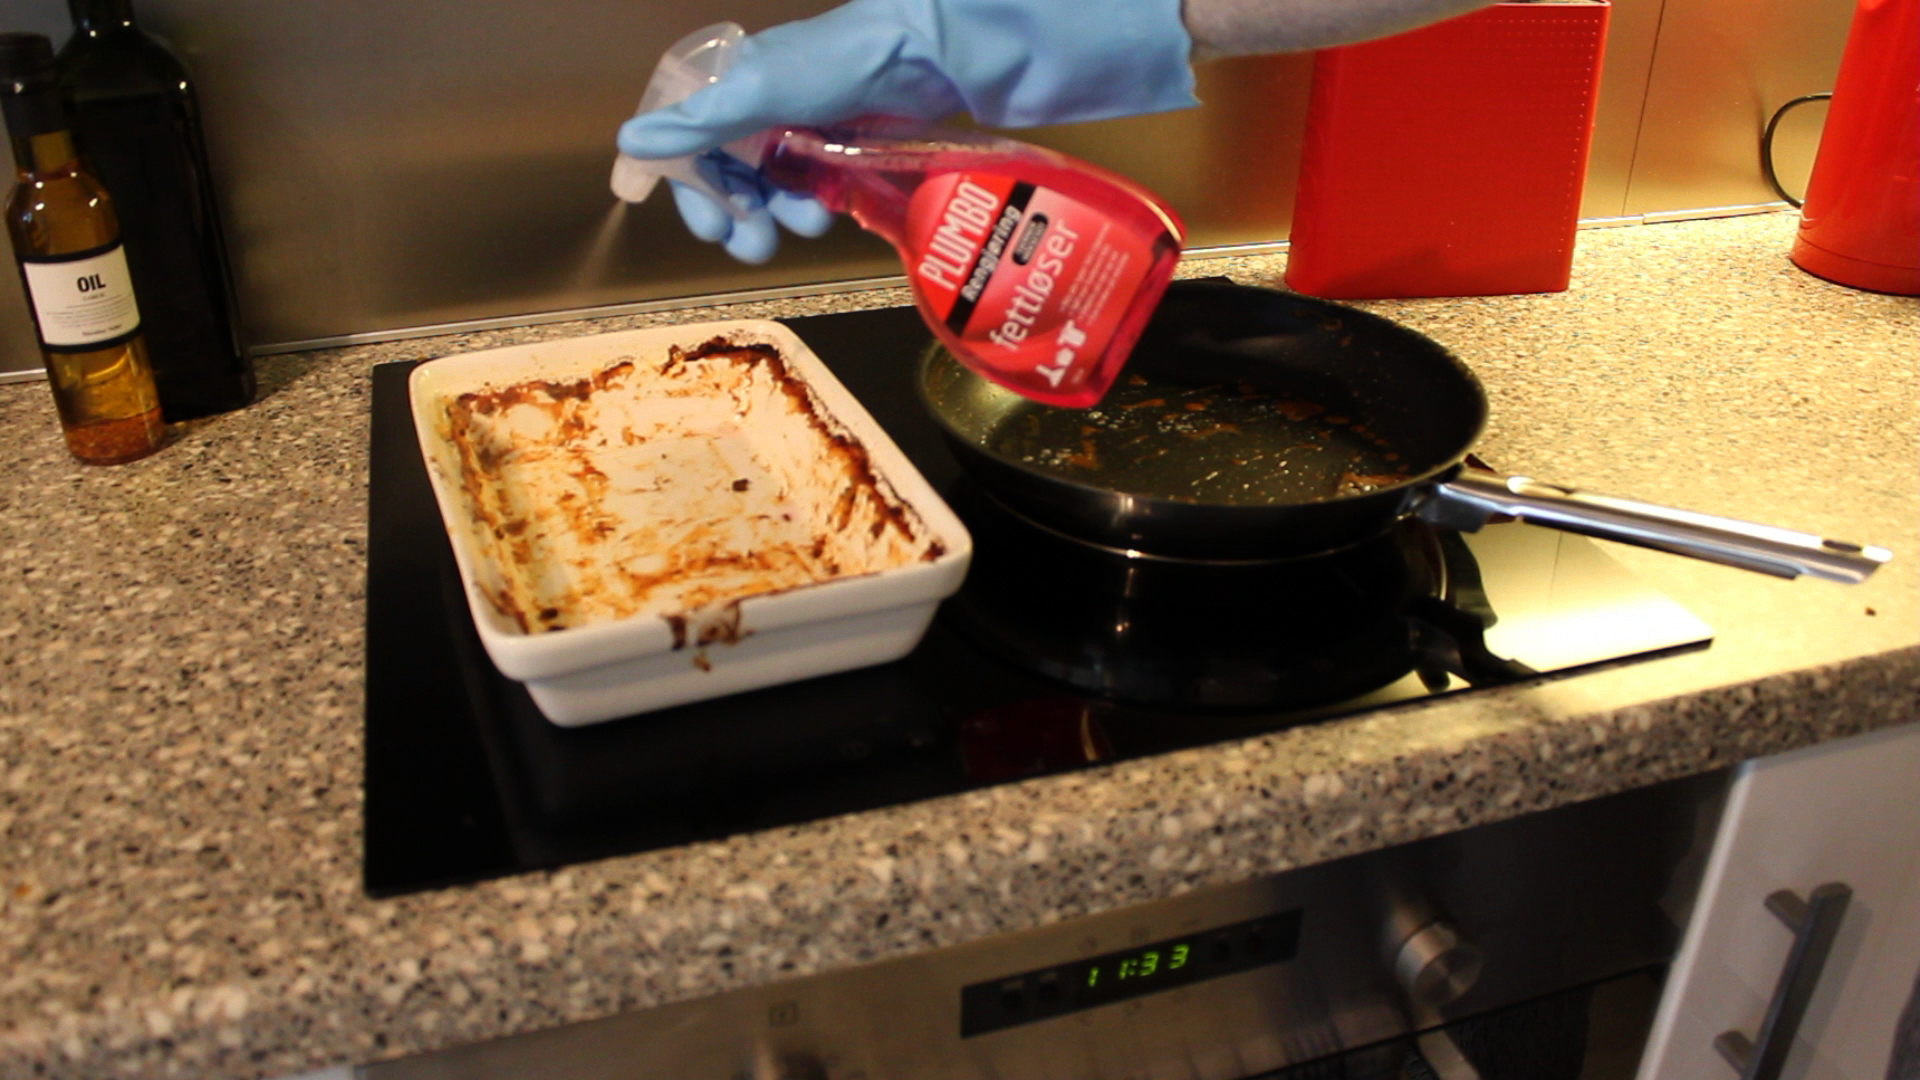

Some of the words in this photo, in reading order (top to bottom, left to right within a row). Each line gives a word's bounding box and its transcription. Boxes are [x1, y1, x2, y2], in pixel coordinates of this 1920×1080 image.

[77, 273, 106, 293] OIL
[918, 180, 1000, 292] PLUMBO
[960, 204, 1024, 302] Rengjøring
[989, 218, 1080, 351] fettløser
[1088, 944, 1190, 987] 11:33
